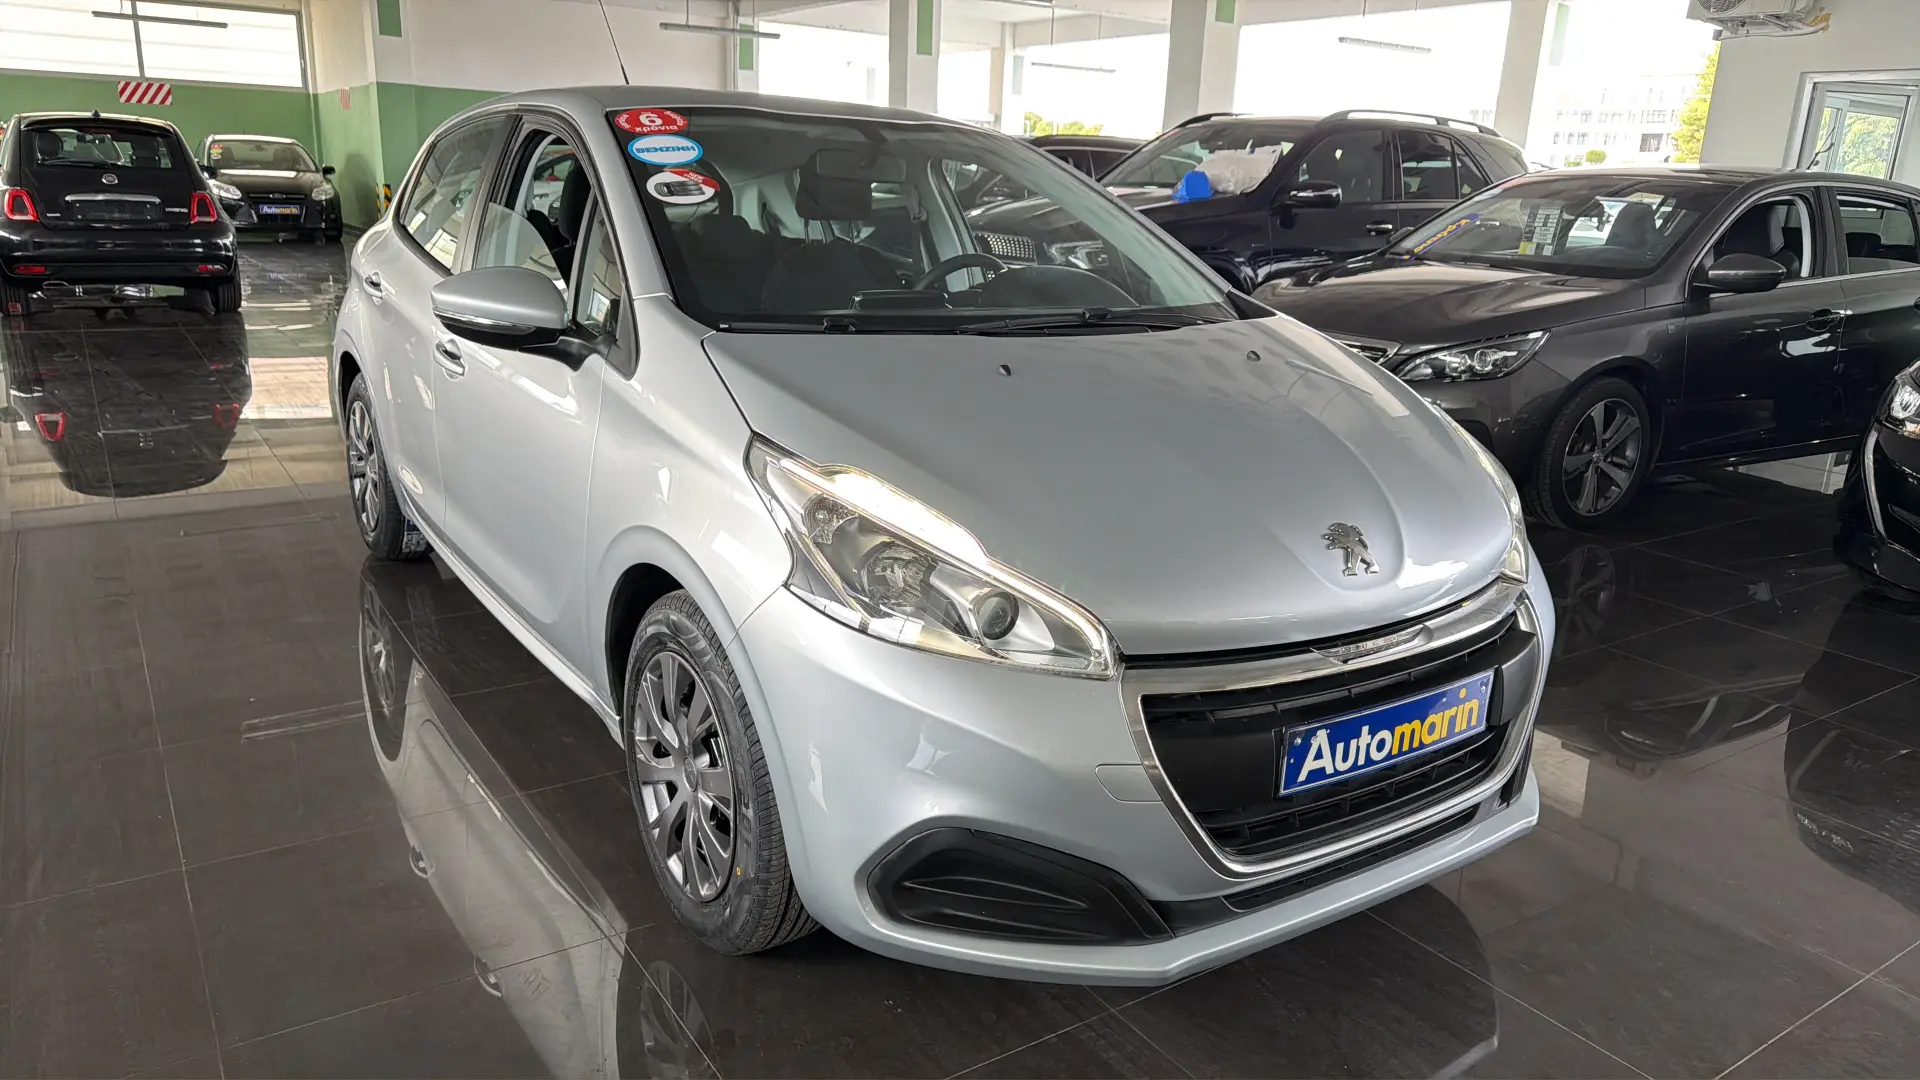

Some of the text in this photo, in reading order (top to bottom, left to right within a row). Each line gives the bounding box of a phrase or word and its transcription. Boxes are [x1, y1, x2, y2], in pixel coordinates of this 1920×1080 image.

[639, 113, 663, 126] 6
[262, 205, 298, 214] Automarin
[1296, 687, 1480, 783] Automarin
